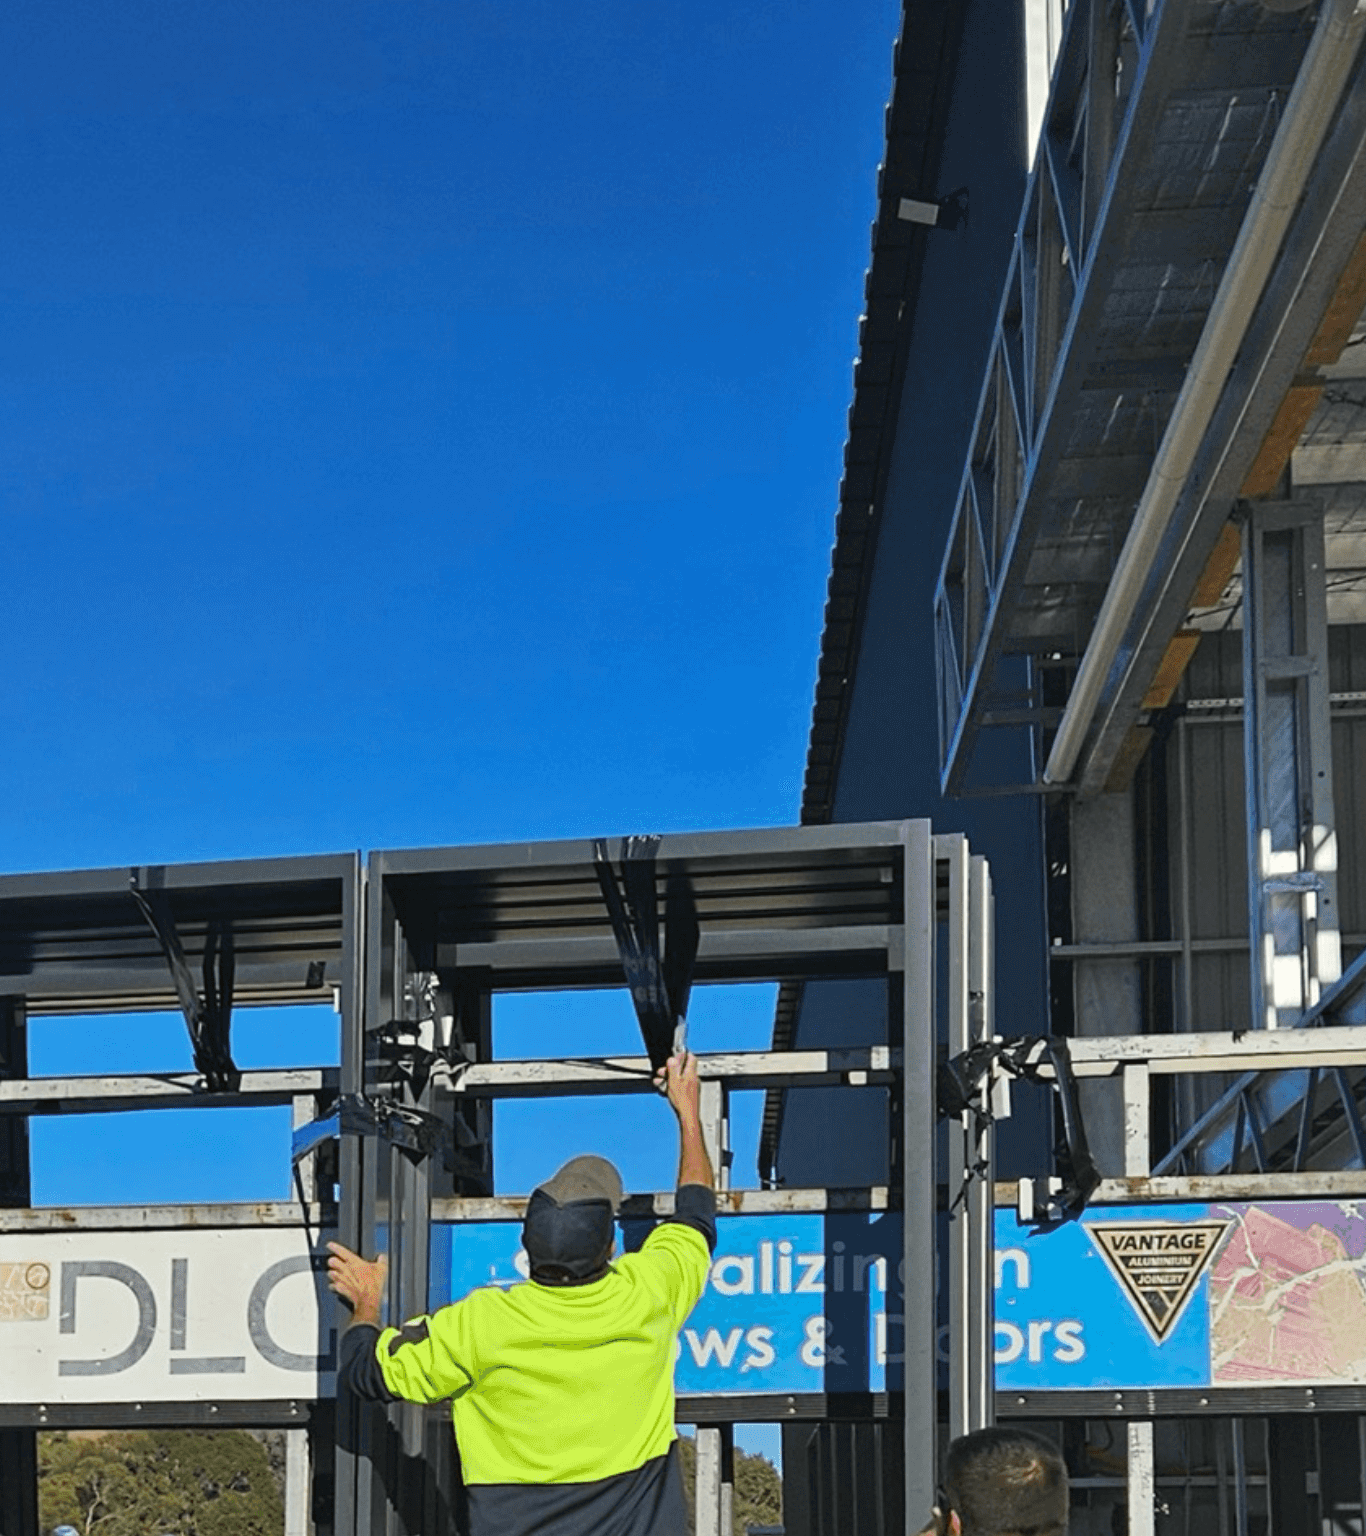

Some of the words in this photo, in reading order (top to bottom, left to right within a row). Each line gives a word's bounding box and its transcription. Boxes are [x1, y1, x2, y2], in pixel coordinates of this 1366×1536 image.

[1110, 1233, 1207, 1251] VANTAGE
[1128, 1256, 1193, 1267] ALUMINIUM
[874, 1313, 1086, 1365] Dors
